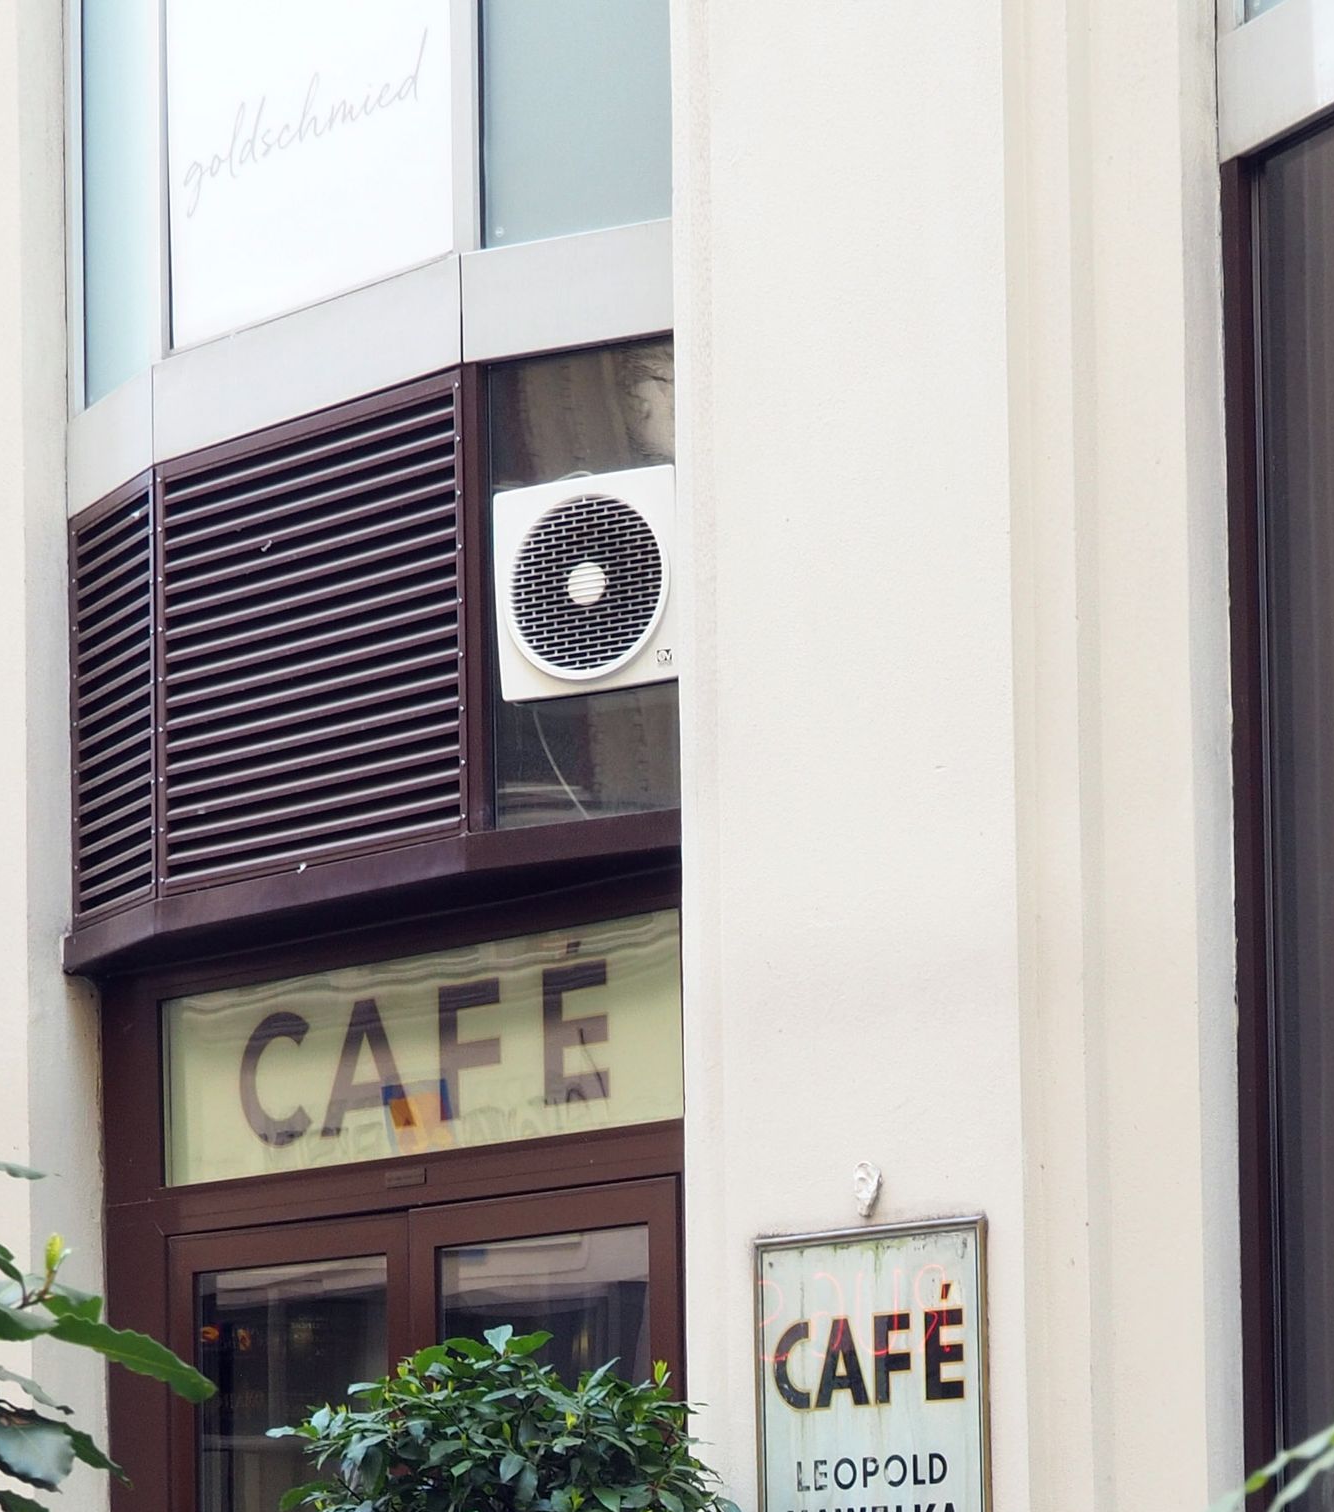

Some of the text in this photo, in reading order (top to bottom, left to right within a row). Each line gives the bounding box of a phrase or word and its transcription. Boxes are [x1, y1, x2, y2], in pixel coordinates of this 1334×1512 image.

[183, 27, 429, 218] goldschmied
[240, 941, 610, 1146] CAFÉ
[773, 1281, 966, 1411] CAFÉ
[796, 1452, 947, 1493] LEOPOLD
